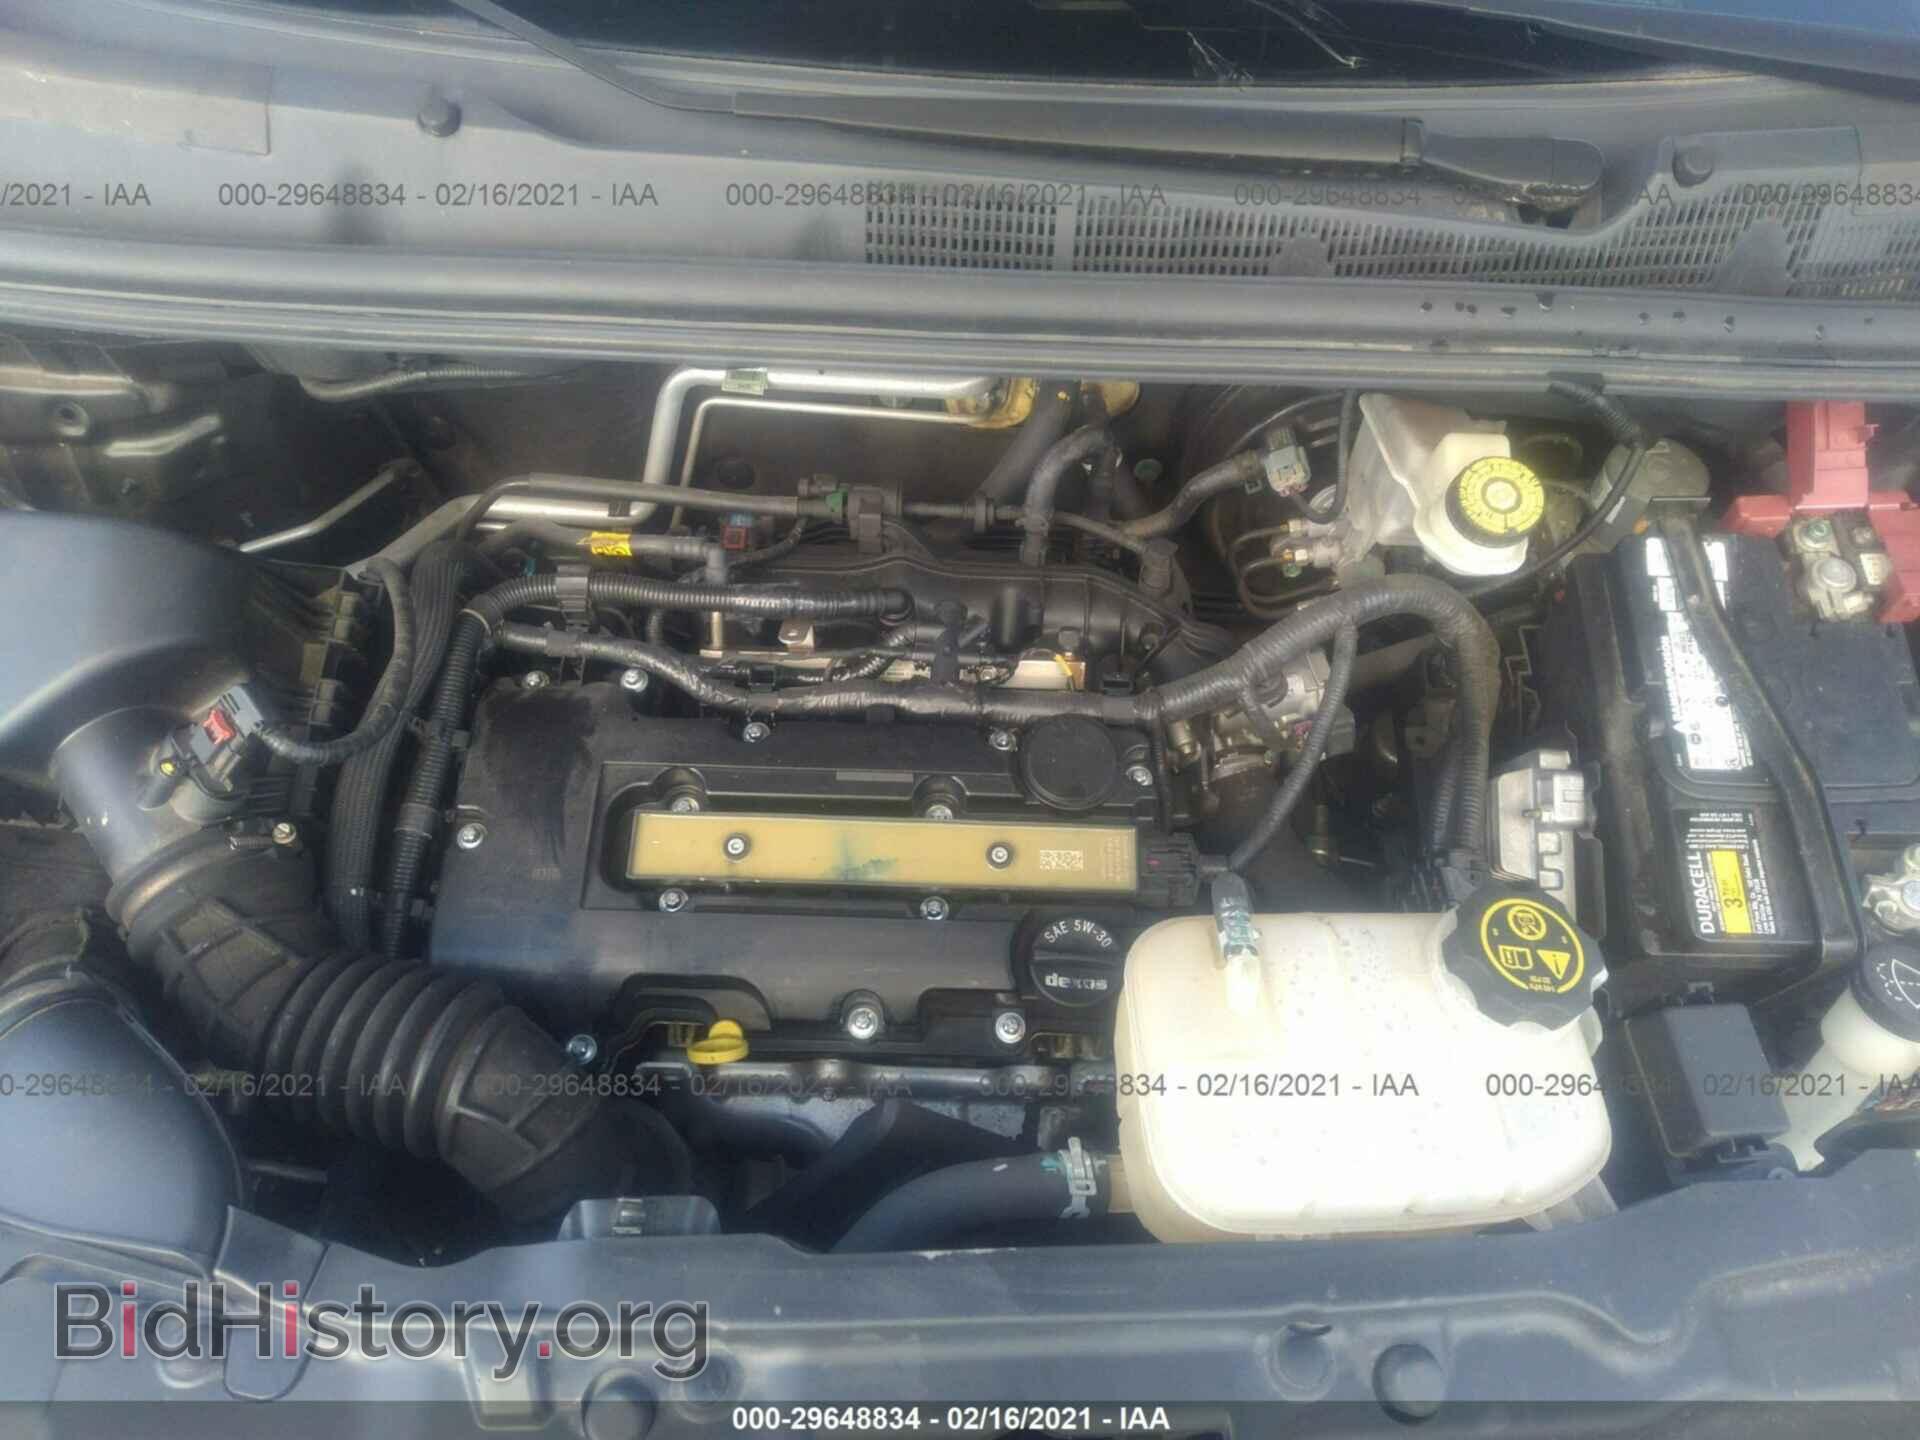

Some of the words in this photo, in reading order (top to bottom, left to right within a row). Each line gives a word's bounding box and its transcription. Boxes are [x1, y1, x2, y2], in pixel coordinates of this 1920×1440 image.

[1687, 851, 1715, 934] DURACELL
[1044, 920, 1070, 943] SAE
[1073, 919, 1113, 948] 5W-30
